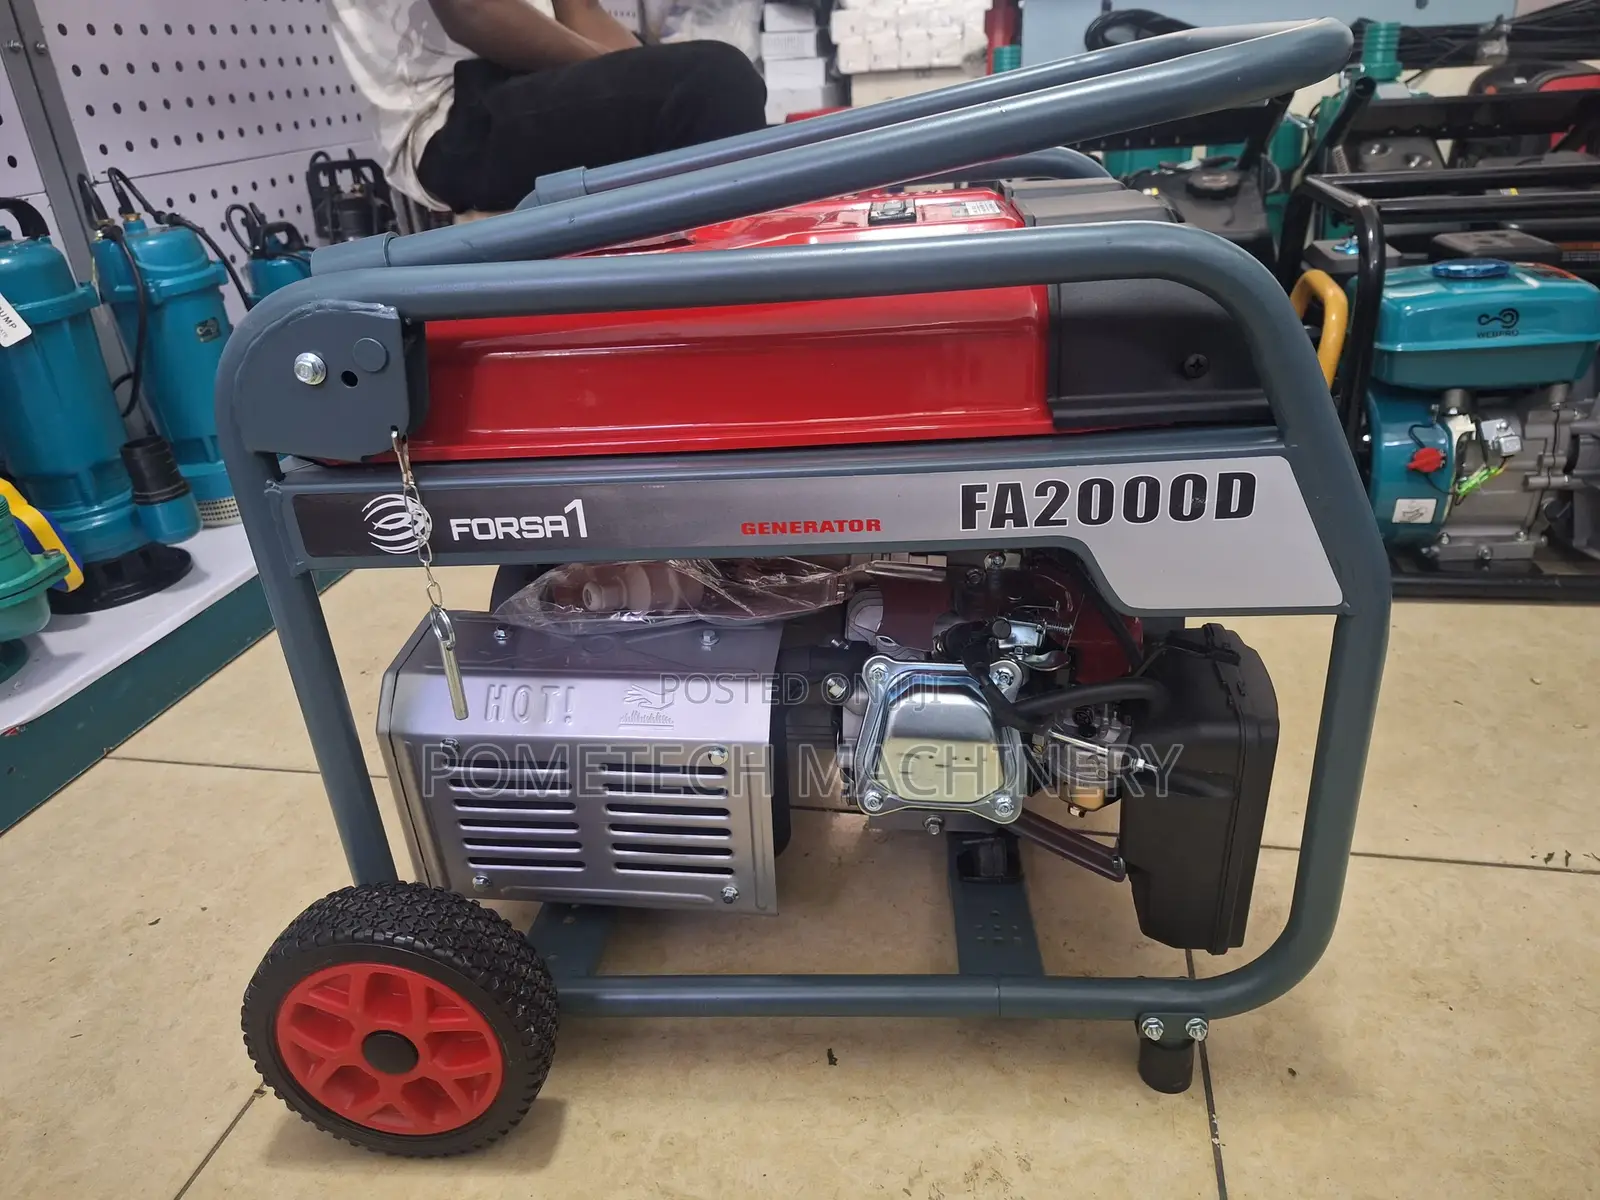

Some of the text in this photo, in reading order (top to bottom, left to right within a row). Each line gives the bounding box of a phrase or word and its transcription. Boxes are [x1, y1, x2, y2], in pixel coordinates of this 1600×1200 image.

[0, 305, 17, 329] UMP
[960, 471, 1256, 531] FA2000D
[741, 519, 881, 535] GENERATOR
[485, 684, 575, 724] HOT!
